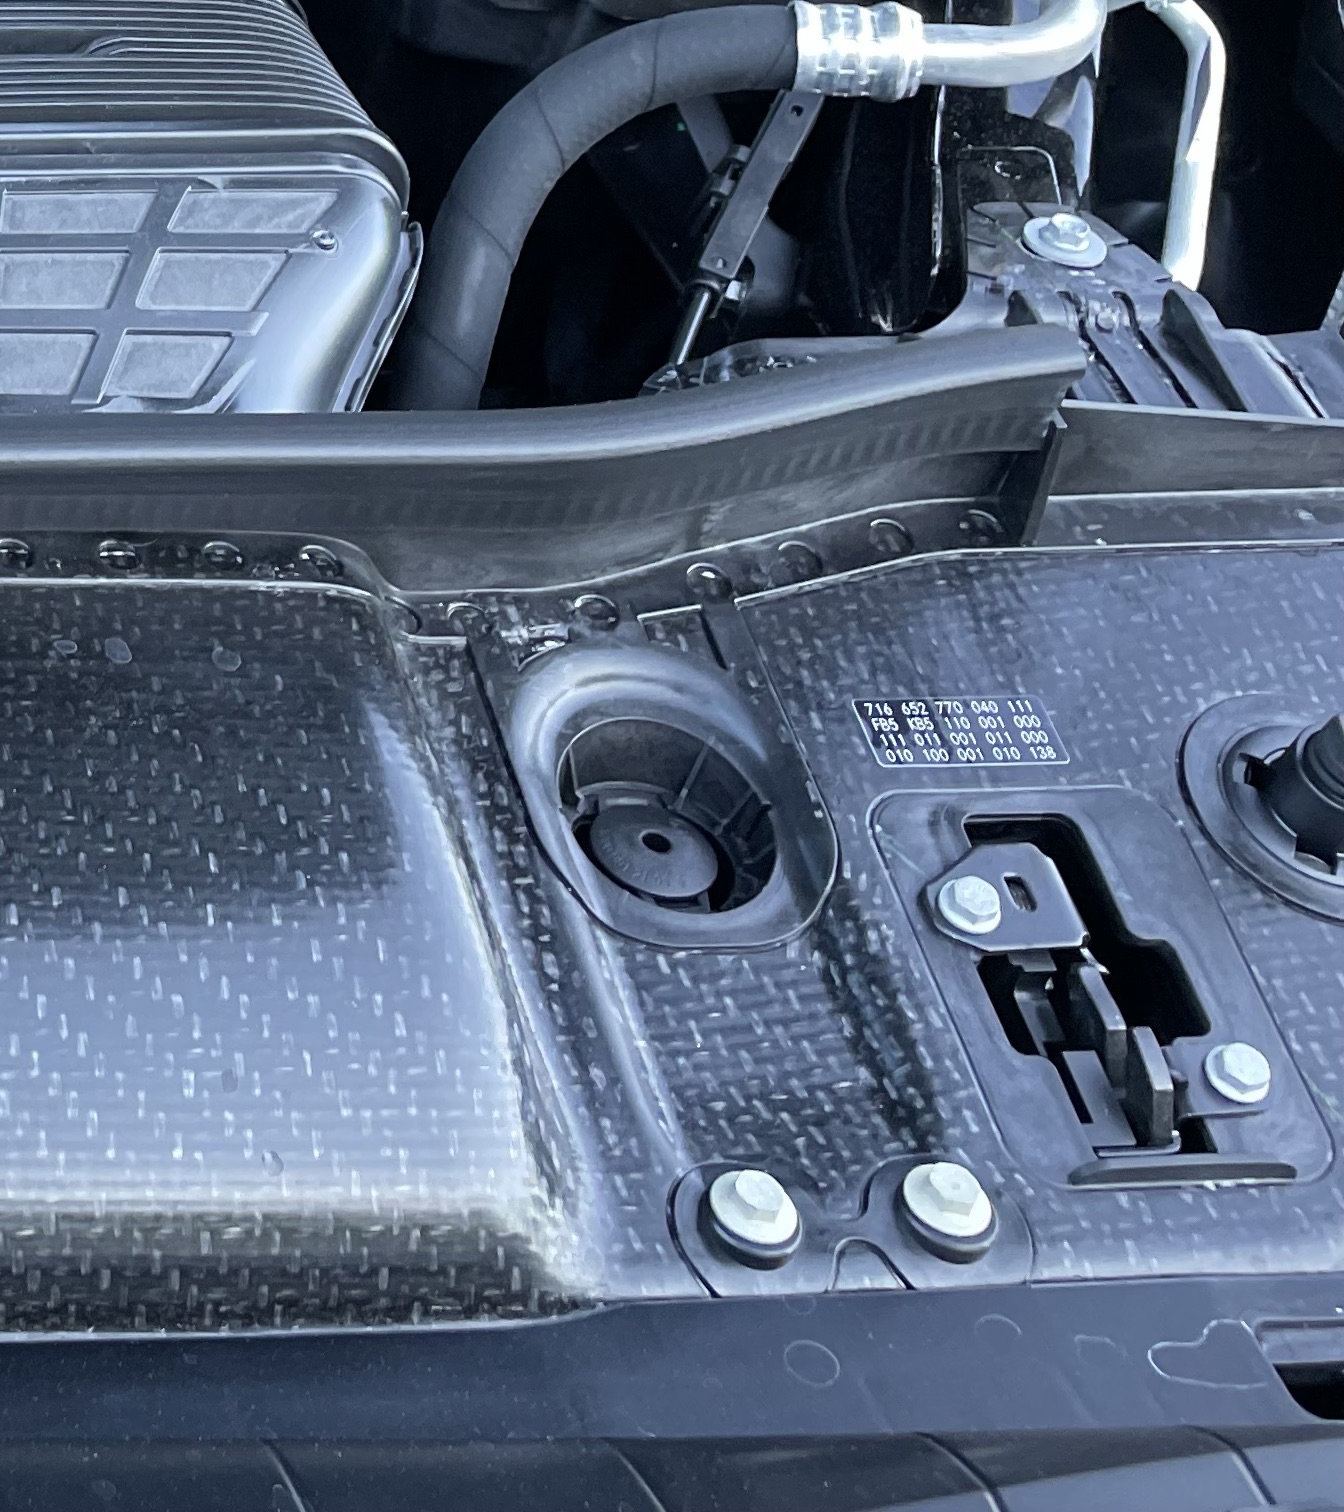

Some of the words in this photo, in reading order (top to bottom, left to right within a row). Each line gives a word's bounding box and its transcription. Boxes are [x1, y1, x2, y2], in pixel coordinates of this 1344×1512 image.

[864, 703, 893, 716] 716
[901, 702, 929, 715] 652
[935, 701, 963, 714] 770
[971, 700, 999, 714] 040
[1007, 700, 1033, 713] 111
[872, 718, 899, 732] FB5
[907, 717, 934, 731] KB5
[944, 716, 971, 730] 110
[978, 715, 1005, 729] 001
[1013, 715, 1041, 728] 000
[880, 734, 906, 747] 111
[914, 733, 942, 746] 011
[949, 732, 977, 746] 001
[986, 731, 1012, 745] 011
[1020, 730, 1049, 744] 000
[885, 749, 913, 763] 010
[922, 749, 949, 762] 100
[957, 748, 984, 761] 001
[992, 747, 1020, 761] 010
[1029, 745, 1056, 760] 138
